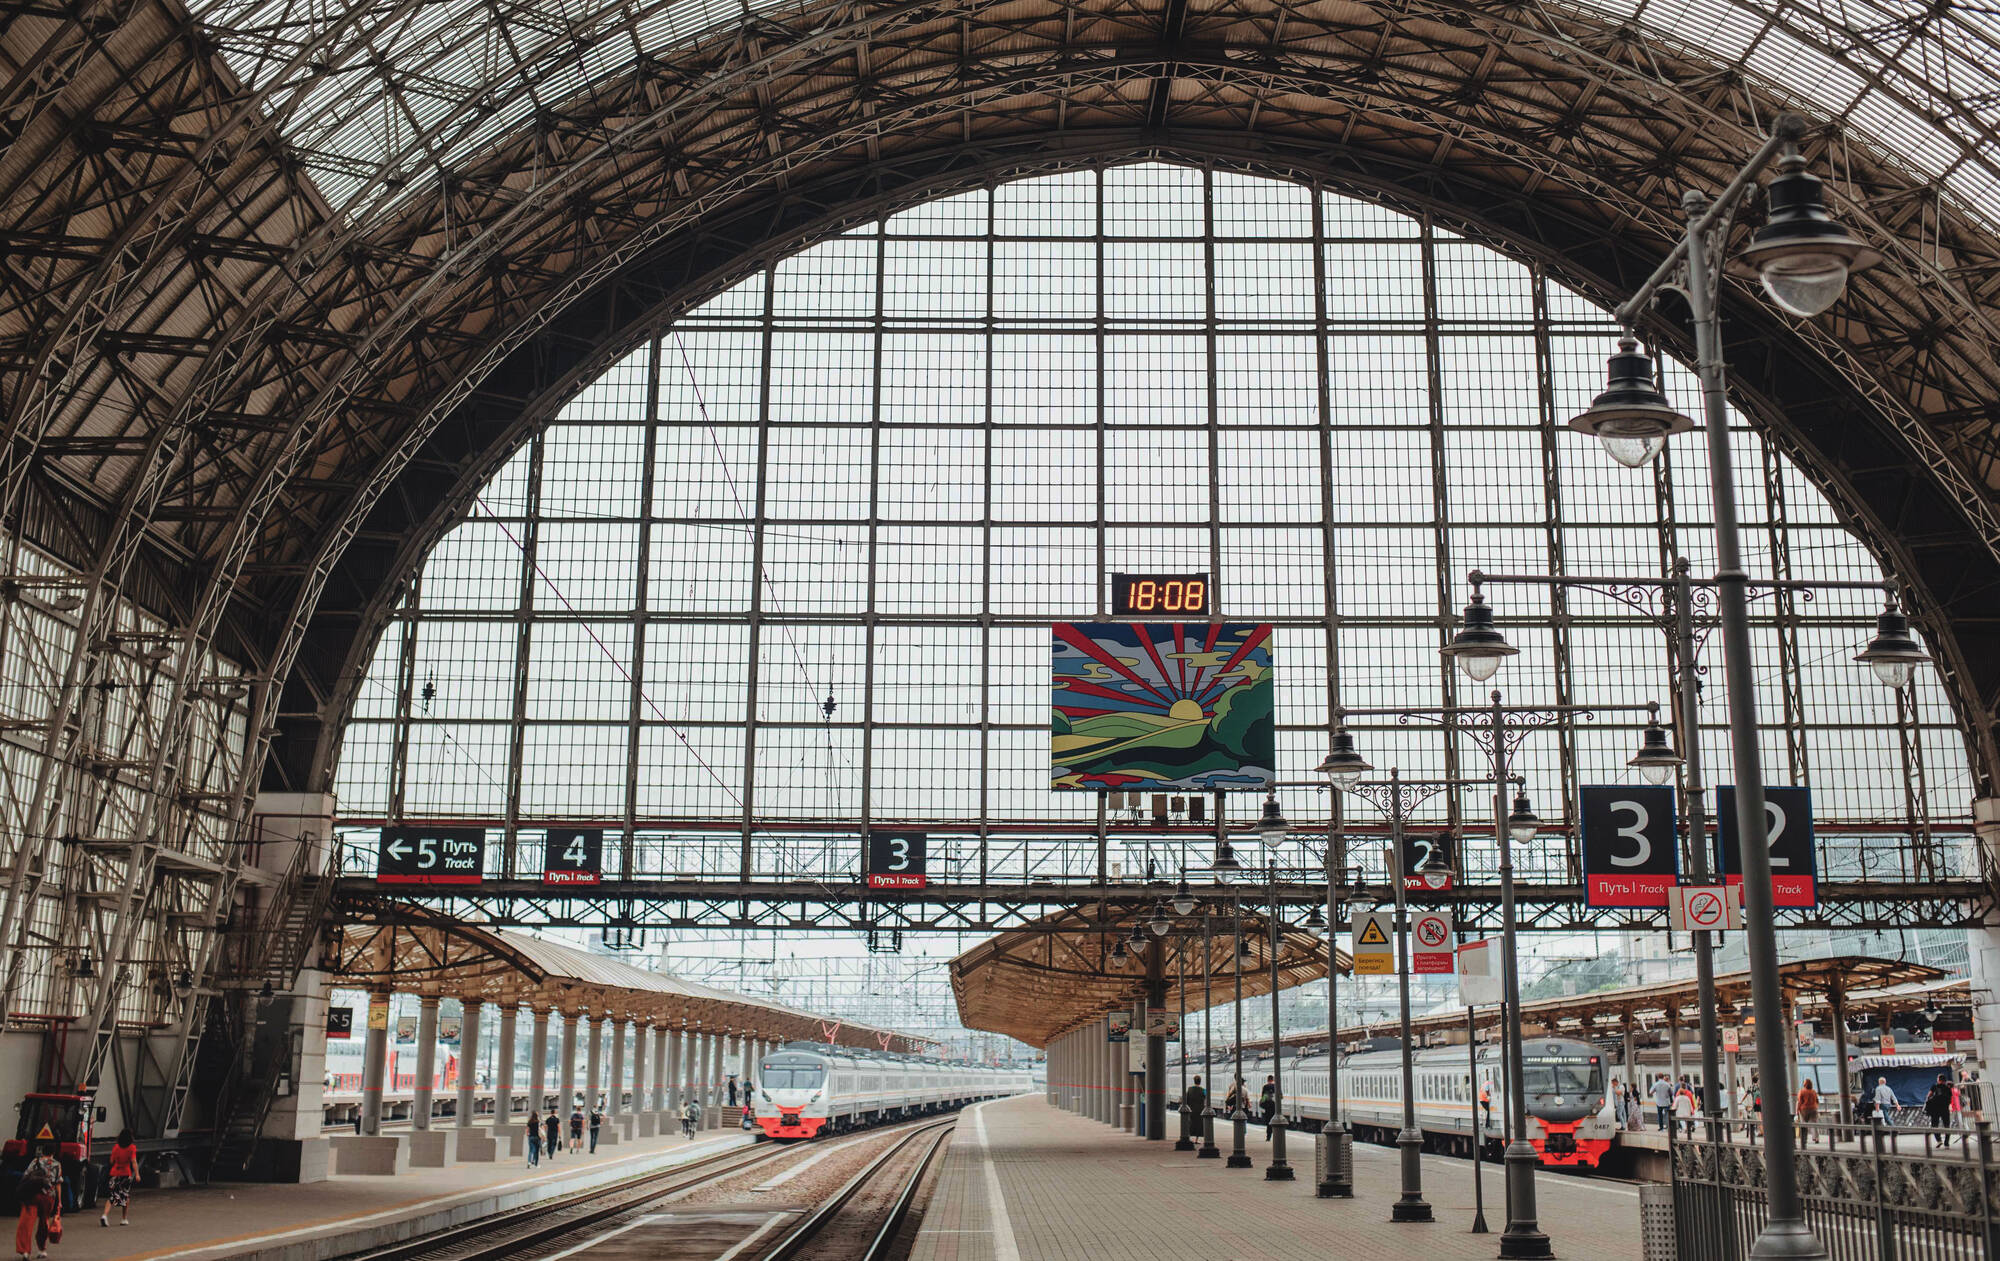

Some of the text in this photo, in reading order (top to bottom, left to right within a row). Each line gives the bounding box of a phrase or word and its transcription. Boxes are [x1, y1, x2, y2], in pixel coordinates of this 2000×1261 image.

[1129, 581, 1204, 610] 18:08
[1610, 800, 1651, 867] 3
[417, 839, 437, 869] 5
[443, 839, 478, 856] Путь
[563, 835, 587, 867] 4
[888, 838, 909, 870] 3
[1413, 840, 1433, 872] 2
[445, 857, 475, 869] Track
[549, 872, 595, 883] Путь Track
[874, 875, 919, 886] Путь Track
[1599, 881, 1665, 896] Путь Track
[1776, 884, 1802, 894] Track
[341, 1014, 350, 1027] 5
